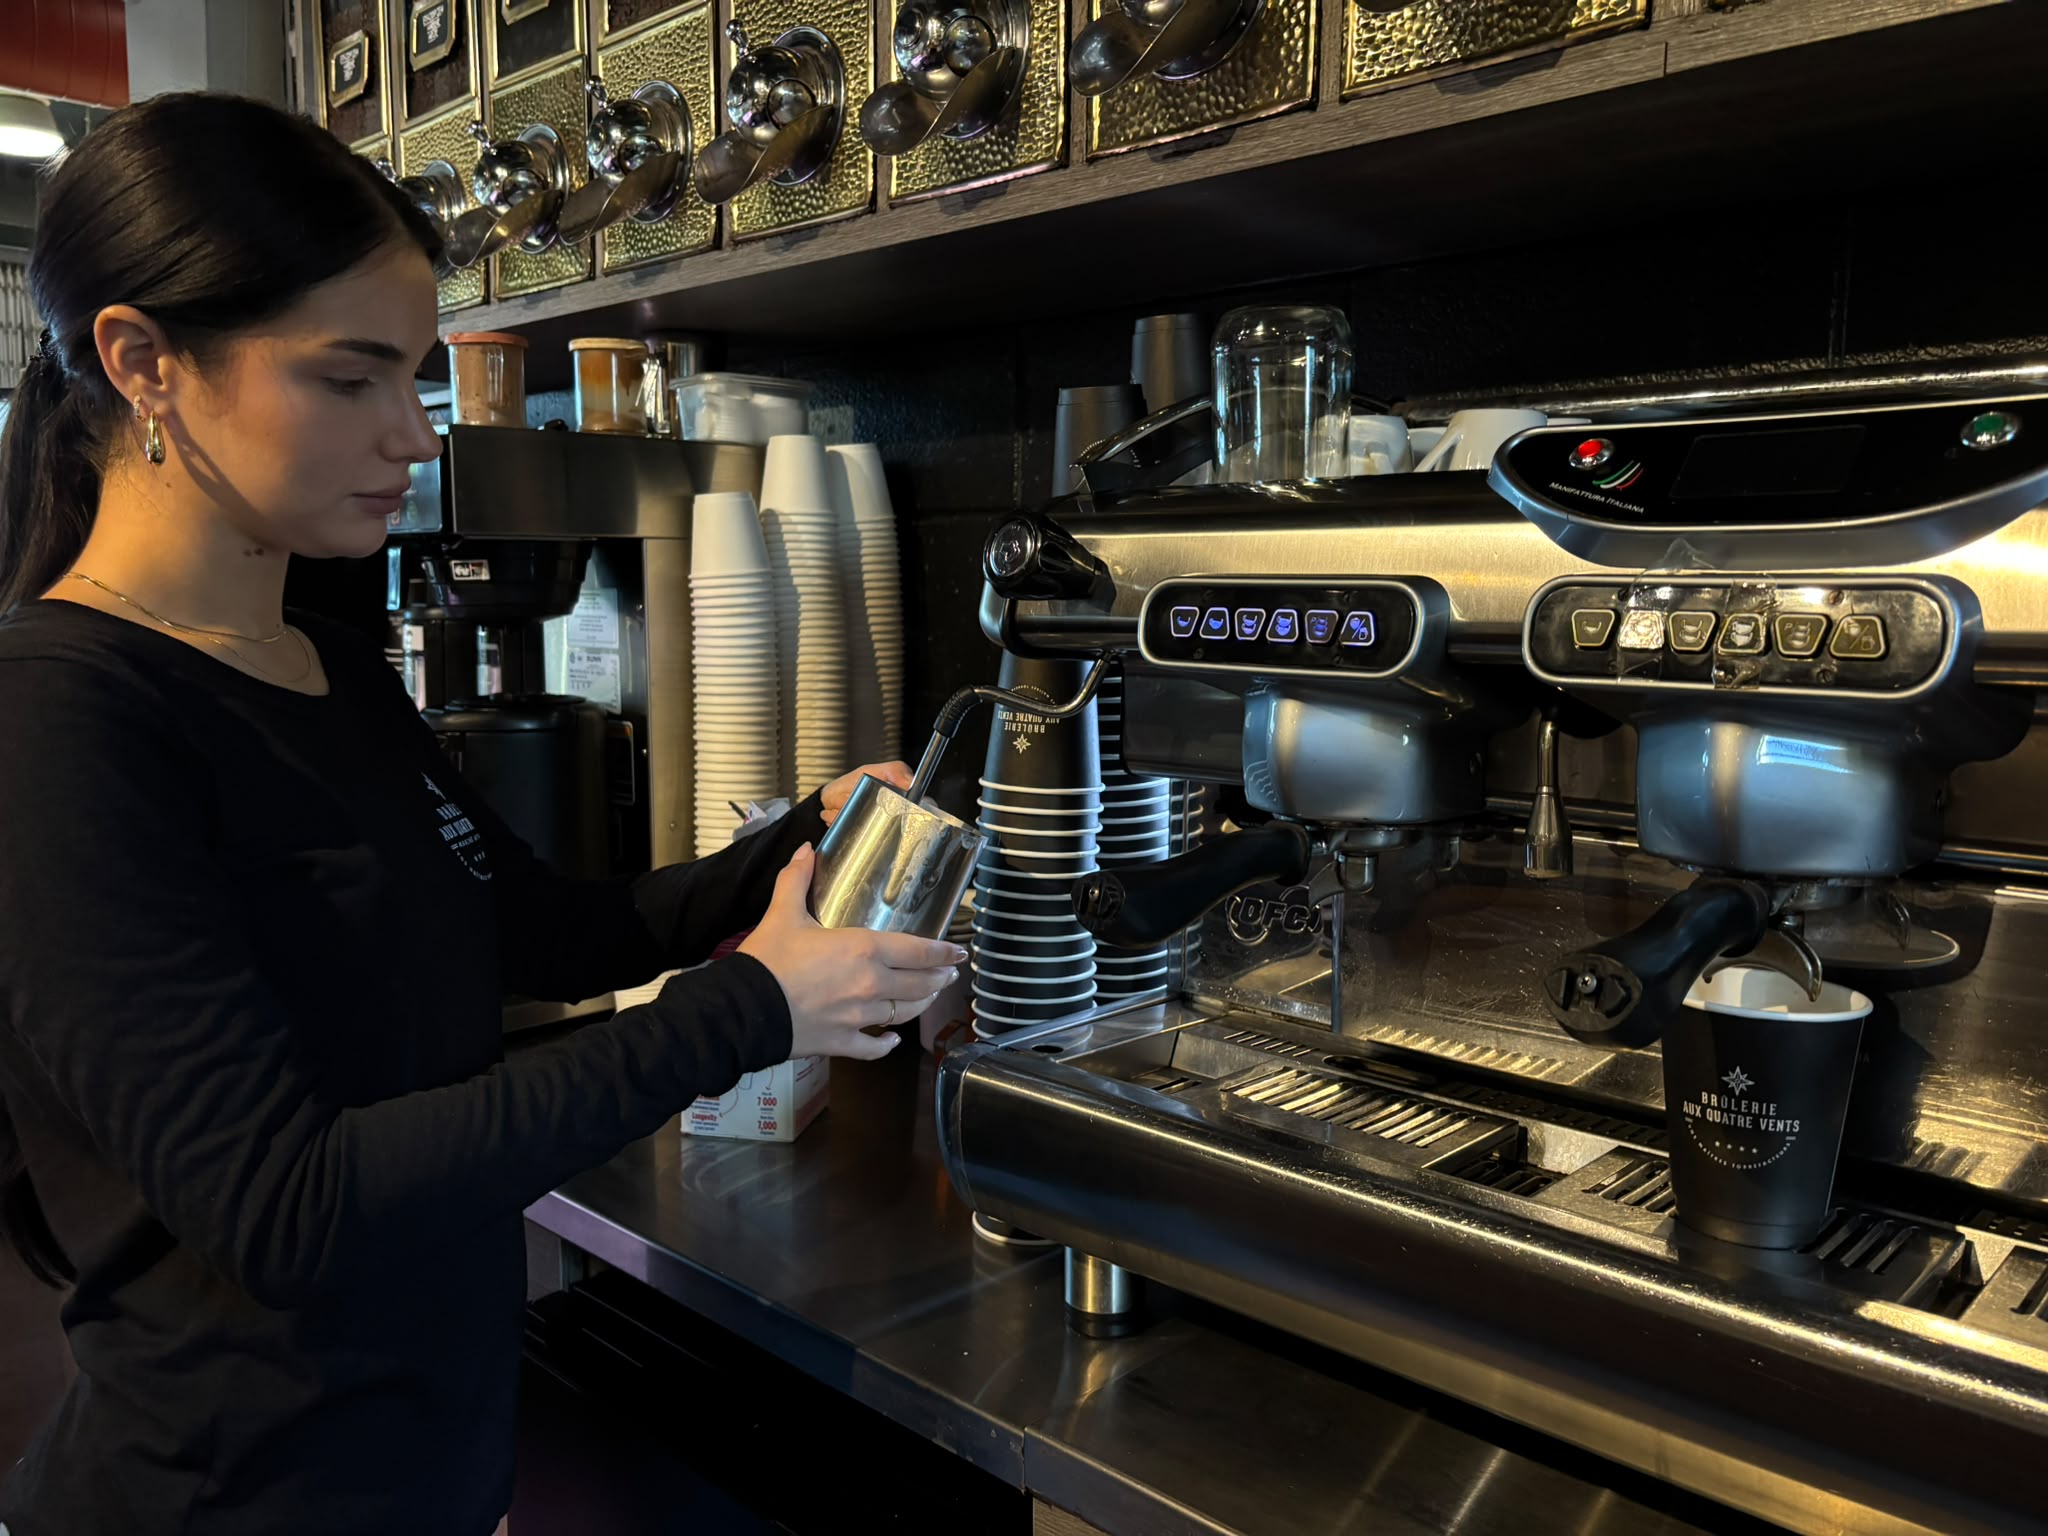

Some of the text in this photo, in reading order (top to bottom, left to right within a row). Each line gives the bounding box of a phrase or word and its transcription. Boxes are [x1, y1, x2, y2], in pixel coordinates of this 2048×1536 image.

[1549, 481, 1644, 513] MANIFATTURA ITALIANA
[1015, 712, 1042, 723] QUATRE
[763, 1096, 777, 1106] 000
[1683, 1100, 1800, 1133] AUX QUATRE VENTS
